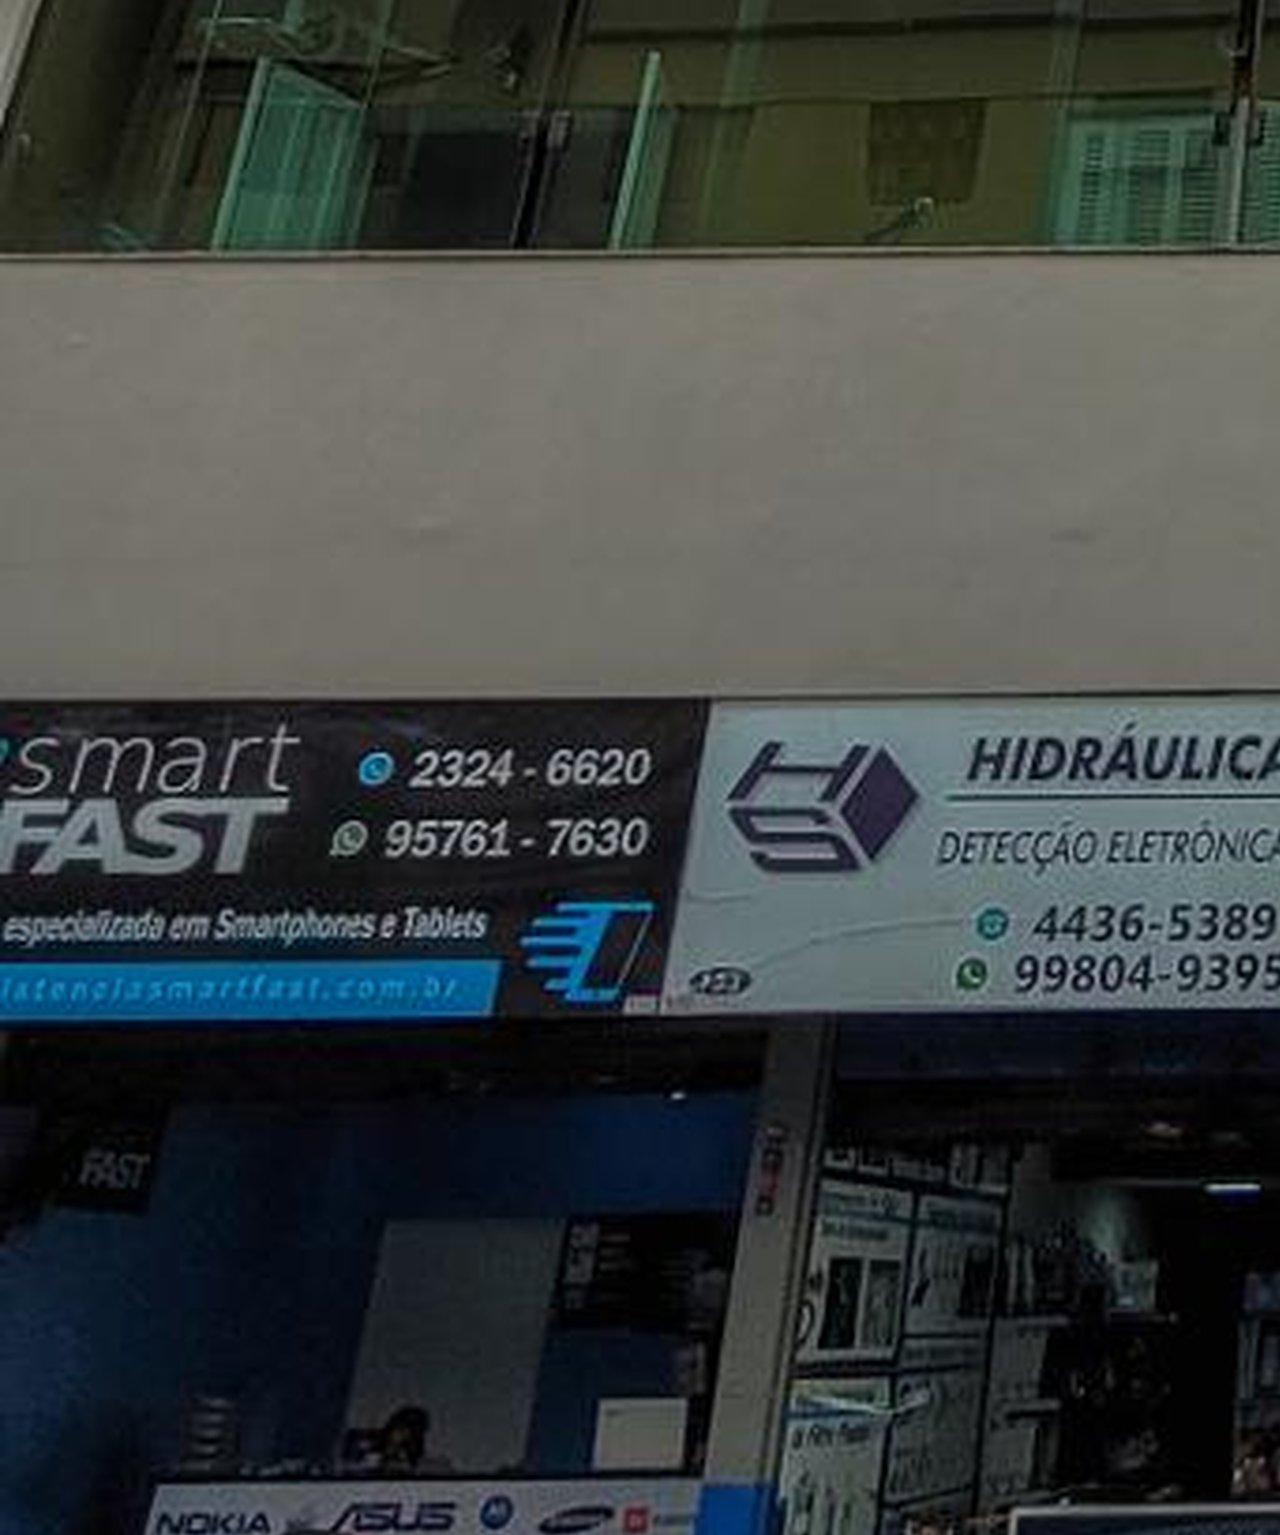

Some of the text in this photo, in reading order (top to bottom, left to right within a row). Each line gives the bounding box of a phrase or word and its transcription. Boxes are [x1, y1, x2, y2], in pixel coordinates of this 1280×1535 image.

[9, 723, 301, 795] smart
[408, 747, 514, 788] 2324
[545, 746, 651, 786] 6620
[0, 796, 291, 875] FAST
[384, 818, 511, 859] 95761
[545, 816, 650, 858] 7630
[938, 820, 1098, 876] DETECÇÃO
[168, 916, 210, 940] em
[214, 907, 377, 948] Smartphones
[379, 914, 399, 939] e
[402, 906, 490, 939] Tablets
[1032, 903, 1278, 942] 4436-5389
[78, 1146, 151, 1190] FAST
[329, 1502, 456, 1533] ASUS
